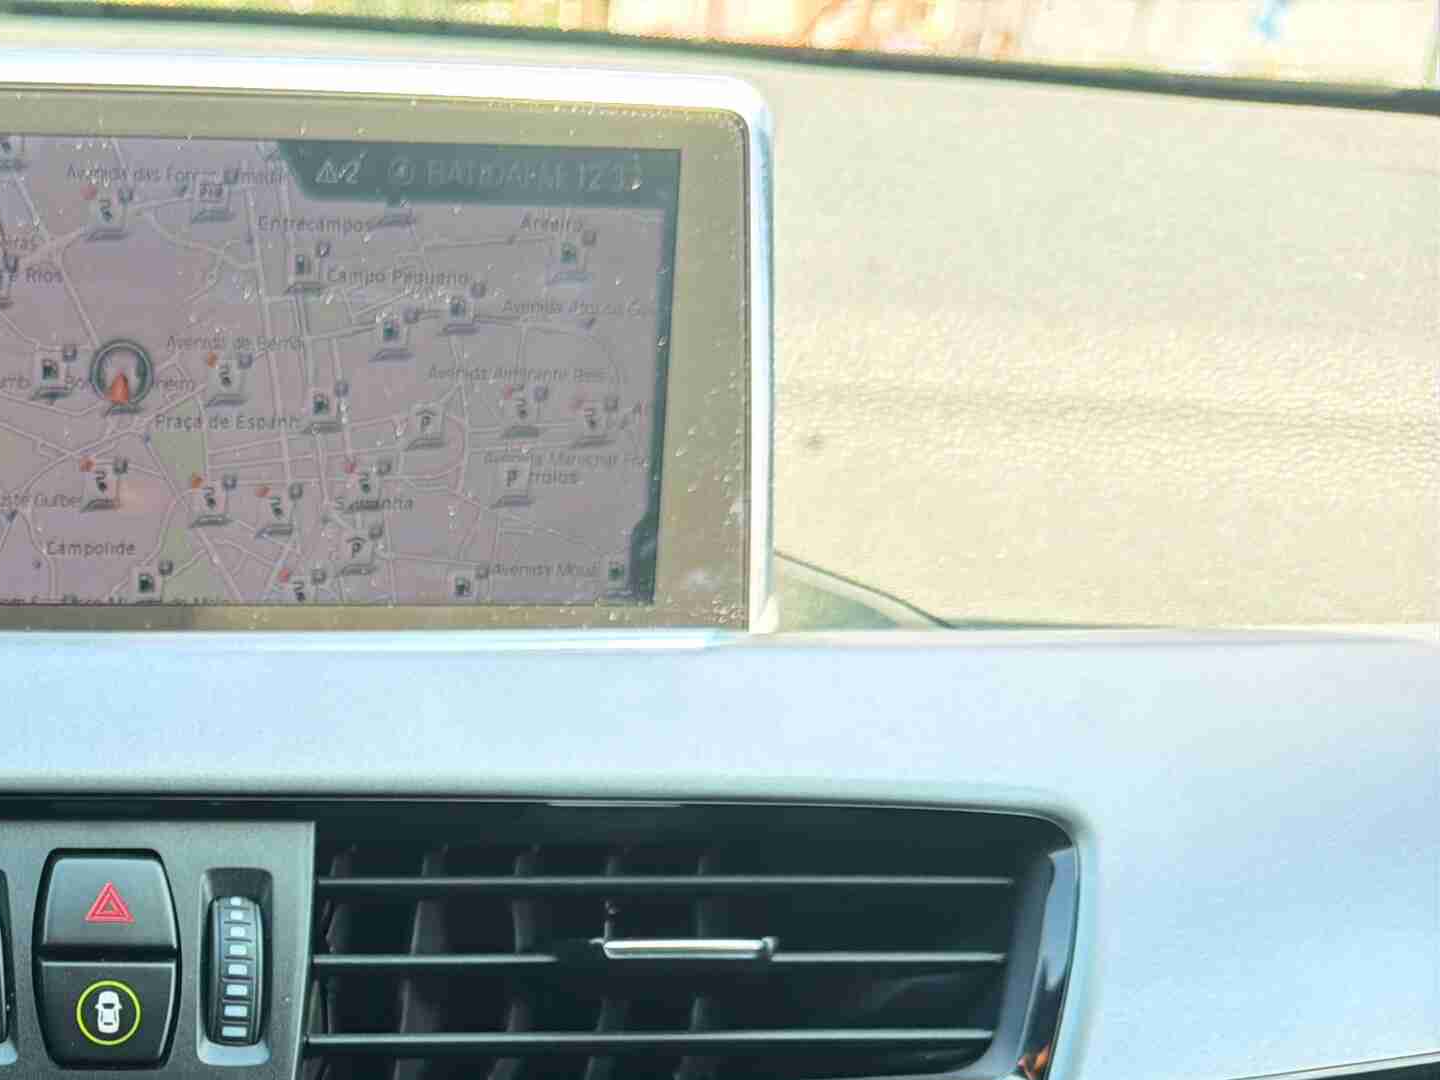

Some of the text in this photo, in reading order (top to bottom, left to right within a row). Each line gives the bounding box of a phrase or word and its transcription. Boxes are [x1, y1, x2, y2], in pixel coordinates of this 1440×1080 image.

[259, 214, 370, 236] Entrecampos
[326, 269, 386, 288] Campo
[155, 414, 301, 433] Praça de Espanh
[46, 540, 136, 558] Campolide
